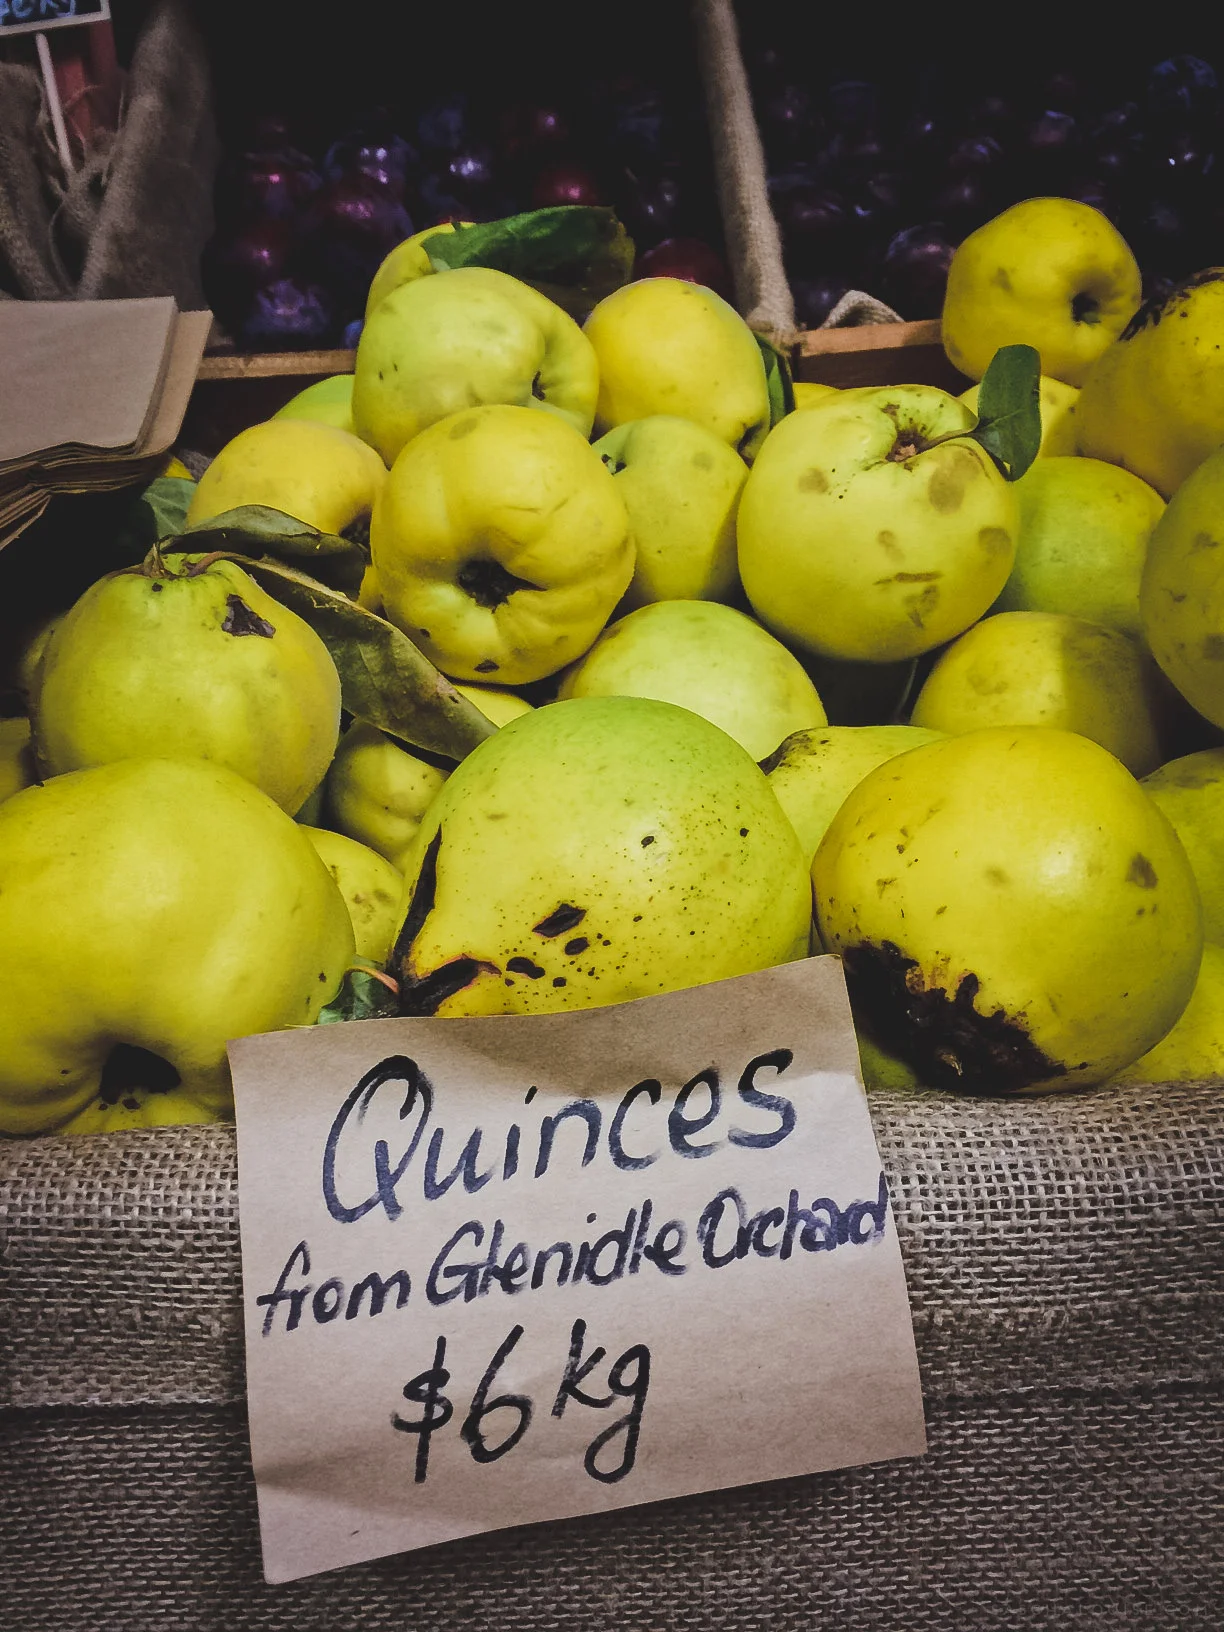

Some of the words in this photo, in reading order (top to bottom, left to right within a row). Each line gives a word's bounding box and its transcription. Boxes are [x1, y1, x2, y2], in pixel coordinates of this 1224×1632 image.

[321, 1049, 798, 1224] Quinces
[256, 1241, 411, 1337] from
[426, 1199, 690, 1304] Glenidle
[697, 1171, 890, 1269] Orchard
[391, 1324, 533, 1485] $6
[551, 1319, 652, 1484] kg
